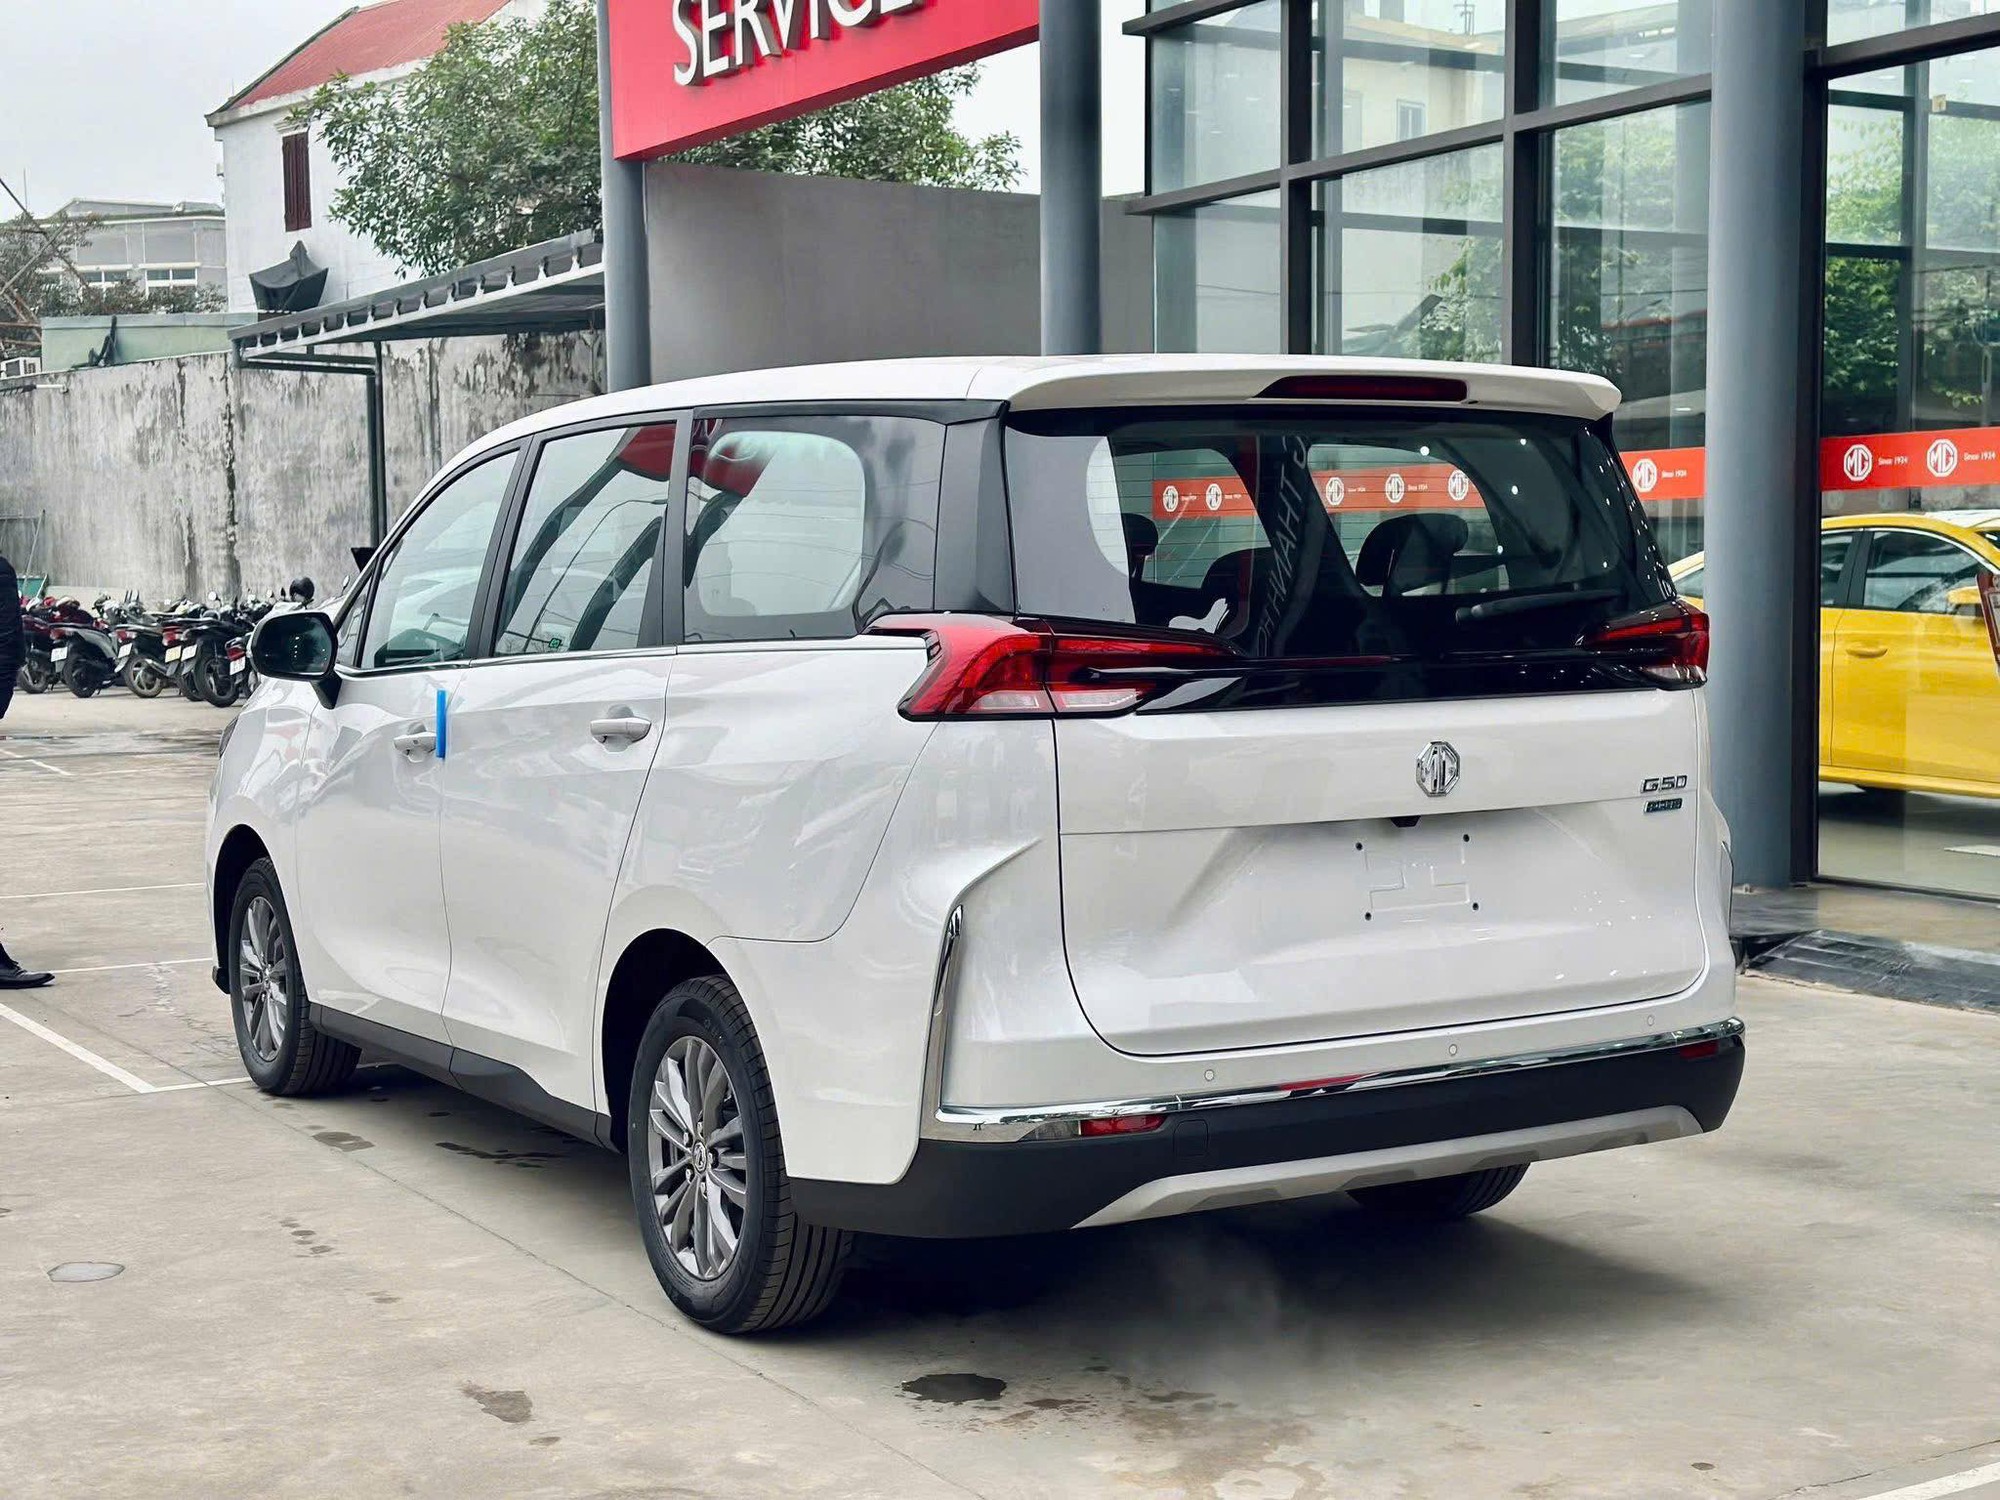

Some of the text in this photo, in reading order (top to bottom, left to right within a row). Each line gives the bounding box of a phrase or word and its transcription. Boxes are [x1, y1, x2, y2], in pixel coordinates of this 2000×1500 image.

[673, 0, 914, 86] SERV
[1845, 446, 1872, 480] MG
[1927, 440, 1957, 476] MG
[1417, 742, 1459, 795] MG
